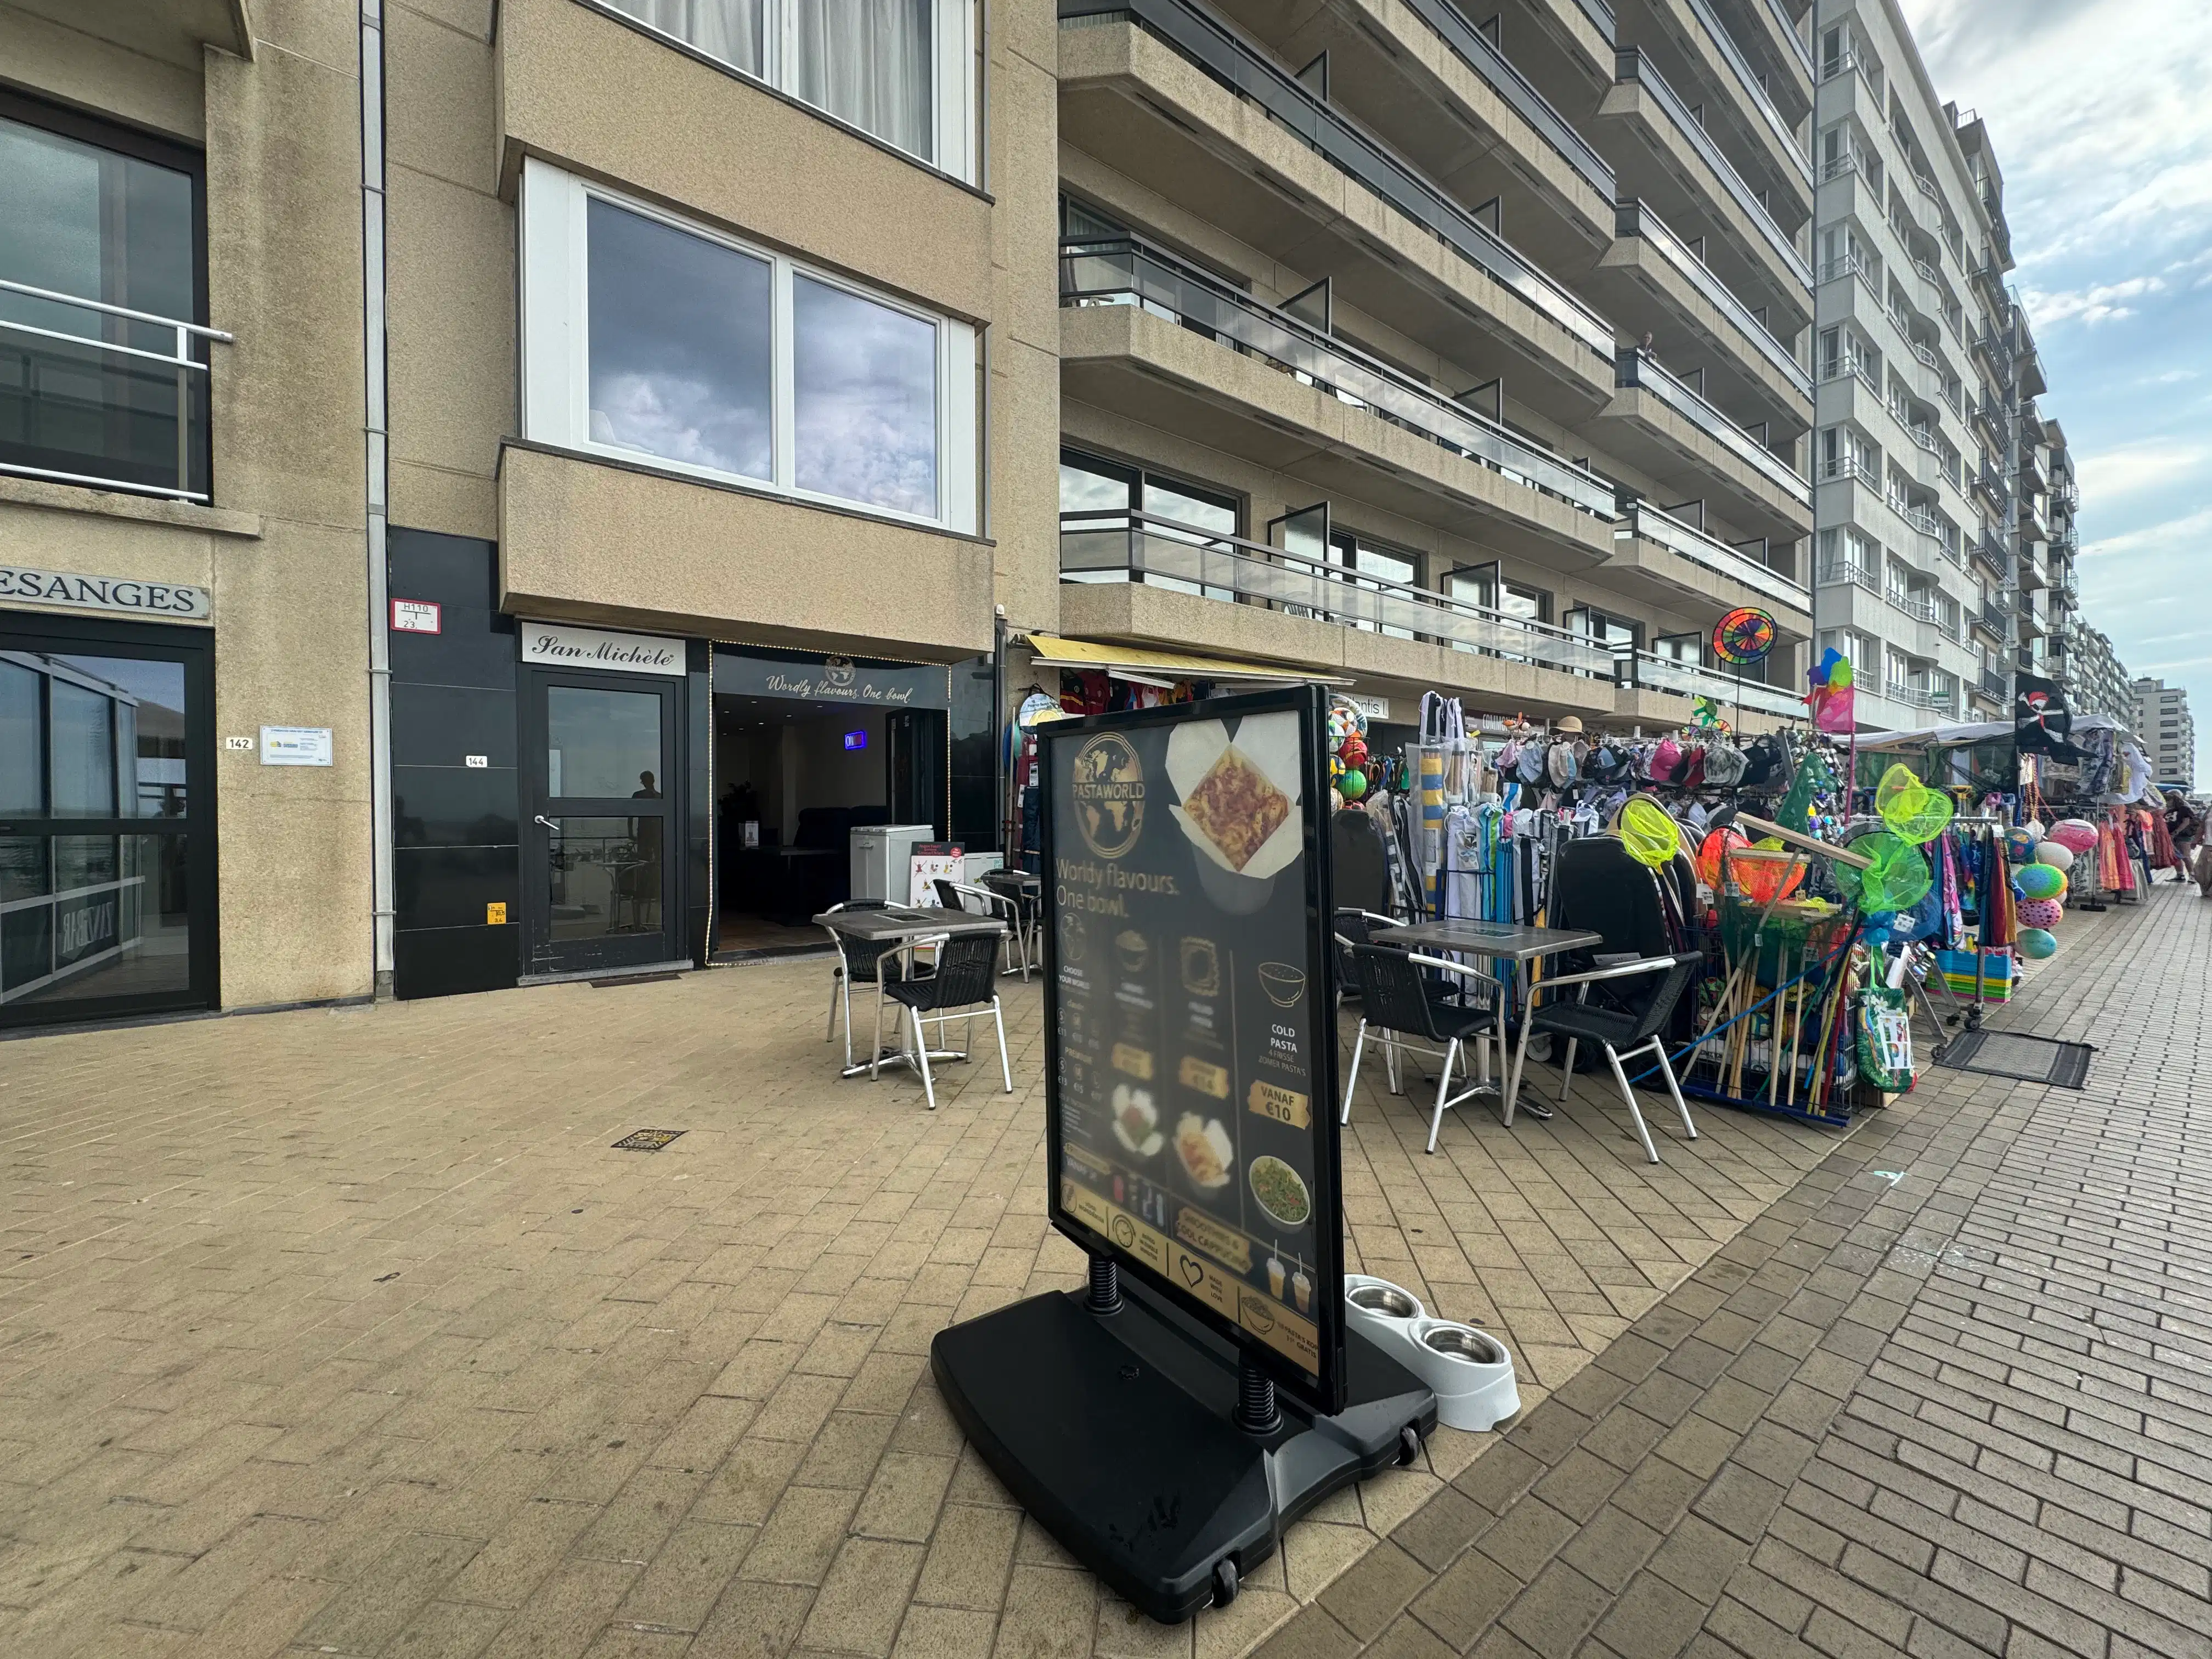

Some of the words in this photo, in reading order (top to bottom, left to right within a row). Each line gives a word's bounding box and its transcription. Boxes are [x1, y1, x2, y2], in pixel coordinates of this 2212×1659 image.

[404, 603, 428, 612] H110
[532, 635, 587, 657] San
[586, 641, 675, 666] Michèle
[766, 674, 811, 698] Wordly
[814, 680, 860, 699] flavours.
[863, 684, 882, 699] One
[884, 687, 913, 704] bowl.
[229, 738, 250, 749] 142
[469, 757, 484, 766] 144
[1072, 783, 1146, 799] PASTAWORLD
[1106, 862, 1180, 895] flavours.
[1056, 885, 1084, 910] One
[1272, 1024, 1295, 1037] COLD
[1270, 1037, 1297, 1053] PASTA
[1258, 1056, 1280, 1069] ZOMER
[1281, 1062, 1306, 1076] PASTA'S
[1273, 1051, 1295, 1063] FRISSE
[1261, 1086, 1295, 1107] VANAF
[1266, 1102, 1291, 1122] €10
